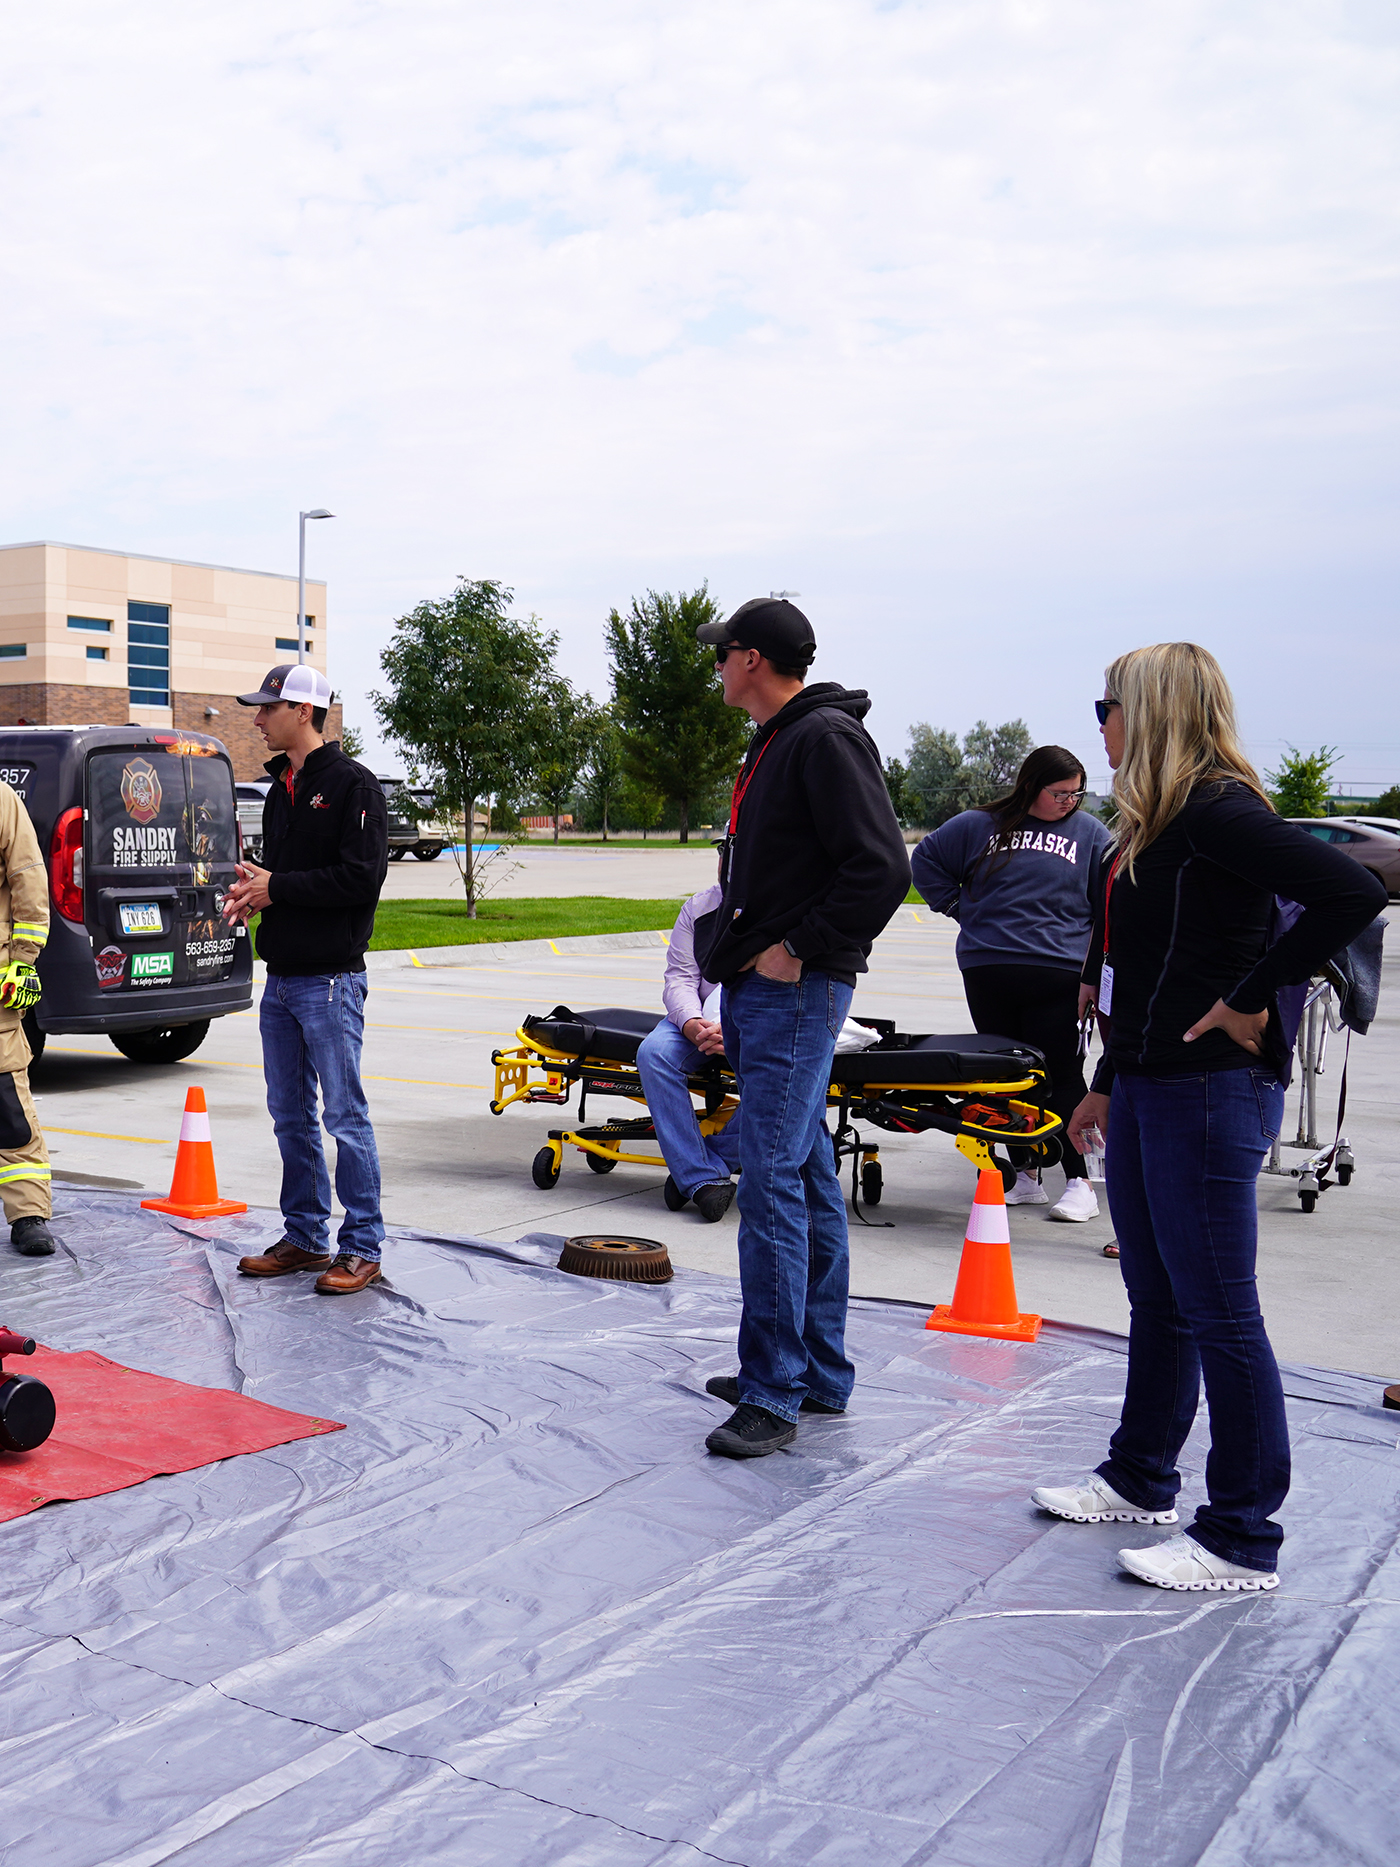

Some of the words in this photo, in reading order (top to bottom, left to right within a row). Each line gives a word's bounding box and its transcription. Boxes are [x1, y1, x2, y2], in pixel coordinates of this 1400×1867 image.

[113, 827, 177, 851] SANDRY
[113, 851, 138, 867] FIRE
[140, 850, 177, 867] SUPPLY
[141, 911, 155, 926] 626
[185, 938, 236, 956] 563-659-2357
[133, 955, 171, 975] MSA
[196, 954, 234, 968] sandryfire.com
[130, 978, 139, 986] The
[139, 977, 153, 987] Safety
[153, 976, 172, 985] Company
